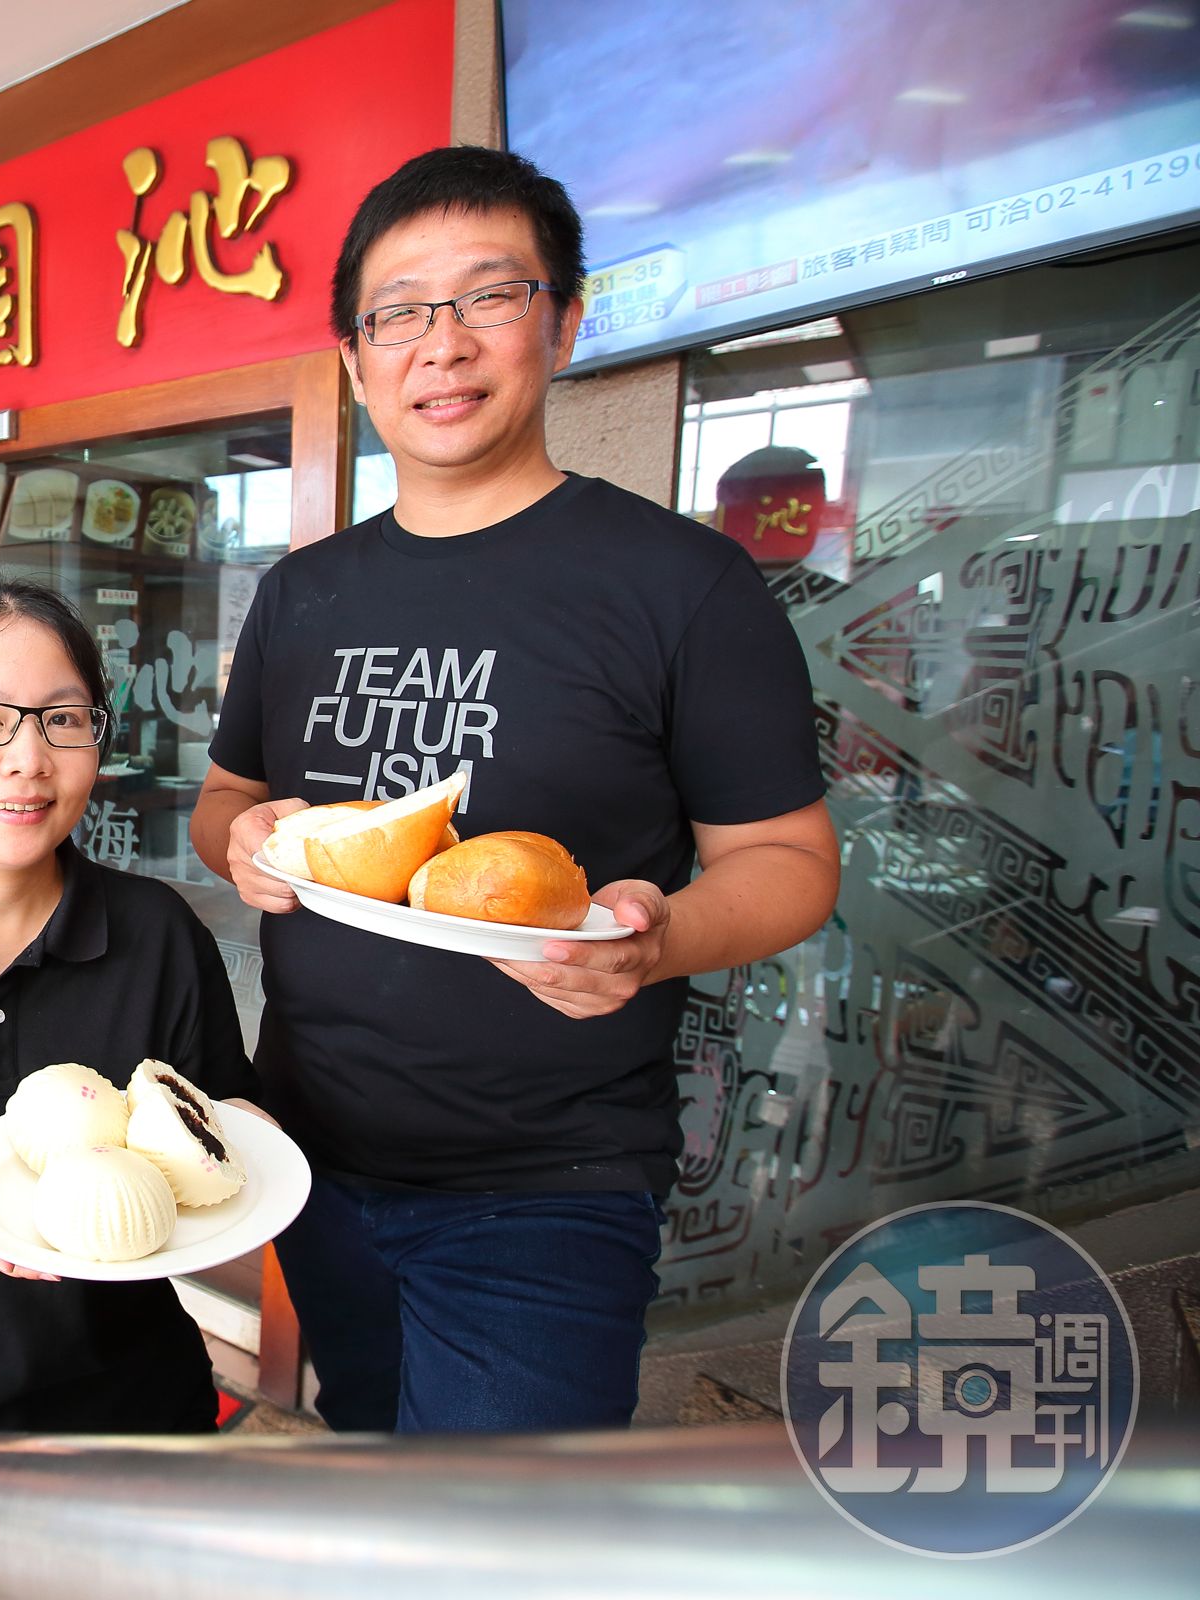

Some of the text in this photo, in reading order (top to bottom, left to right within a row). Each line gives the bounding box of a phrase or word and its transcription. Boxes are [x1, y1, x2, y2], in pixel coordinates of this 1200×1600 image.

[802, 219, 951, 279] 旅客有疑問
[931, 270, 968, 286] TECO
[333, 646, 497, 701] TEAM
[303, 696, 499, 759] FUTUR
